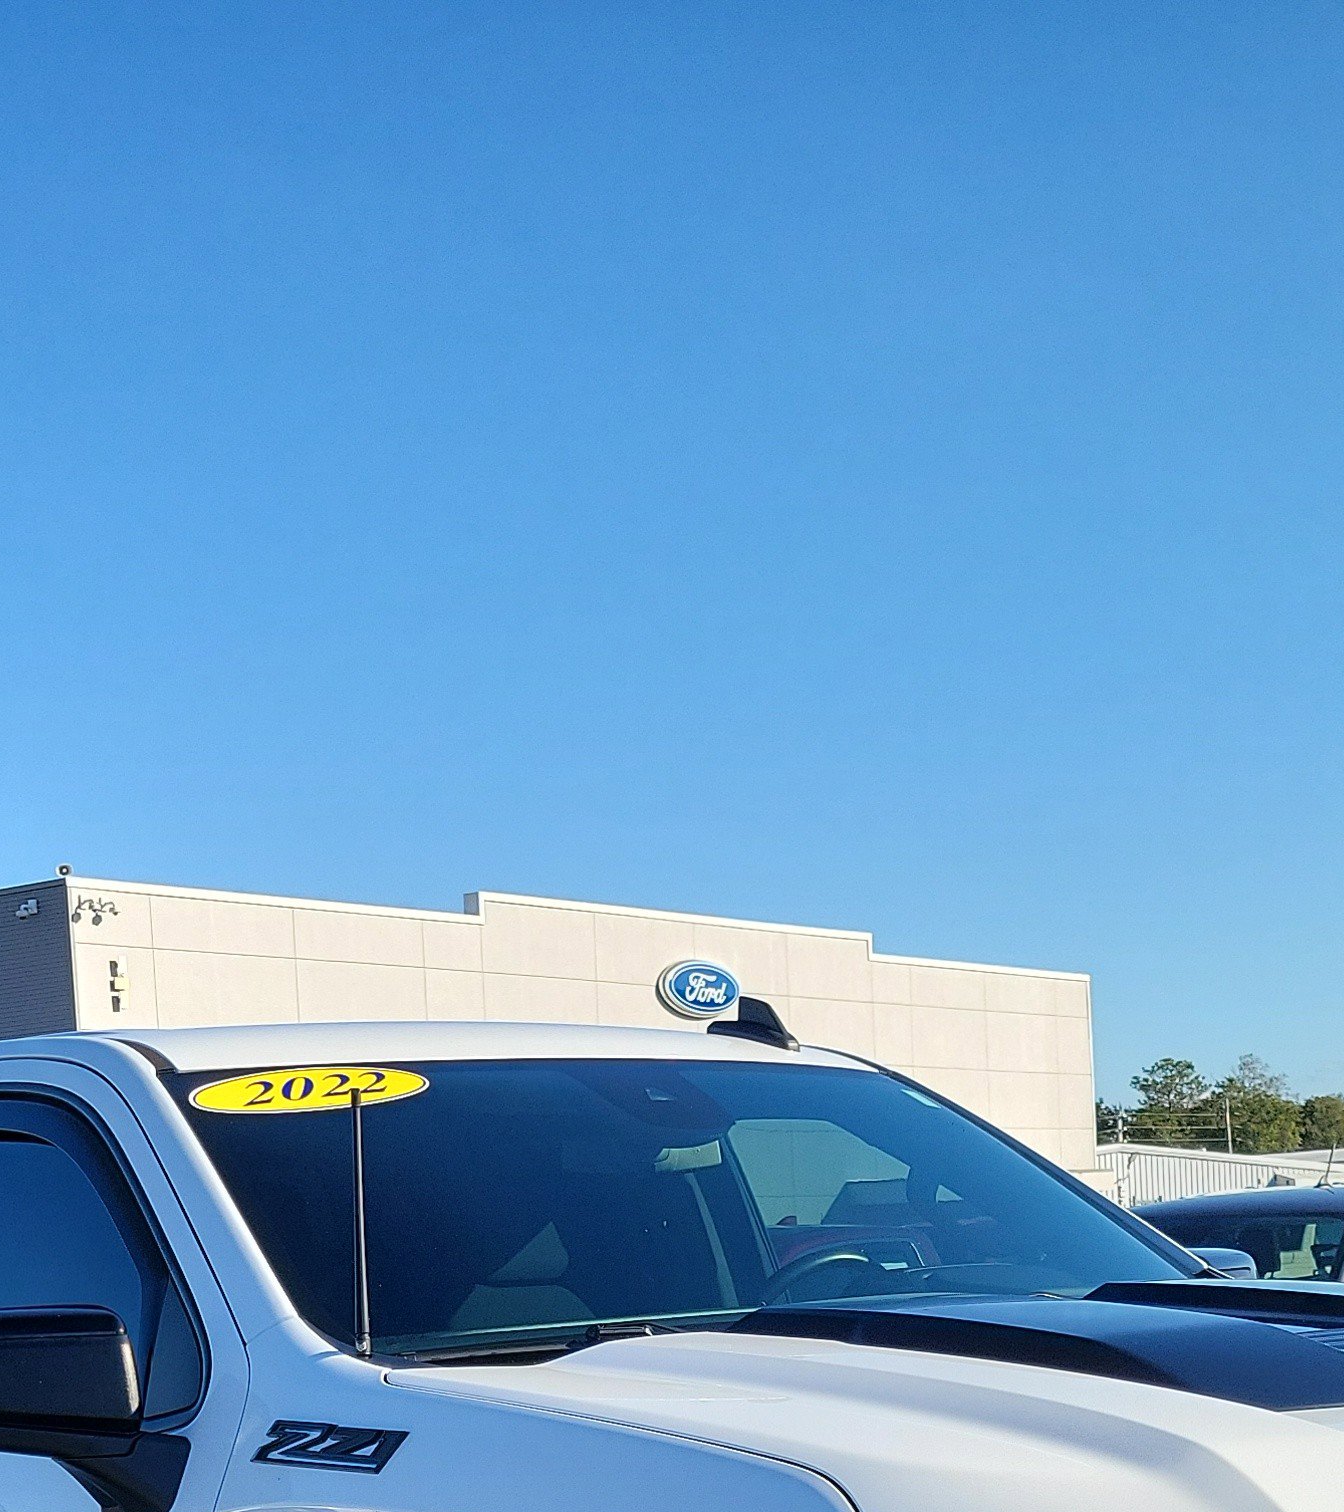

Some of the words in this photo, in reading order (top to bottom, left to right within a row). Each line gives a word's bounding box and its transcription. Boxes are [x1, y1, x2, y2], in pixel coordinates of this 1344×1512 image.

[685, 972, 727, 1004] Ford
[244, 1071, 387, 1106] 2022
[250, 1419, 410, 1474] Z71
